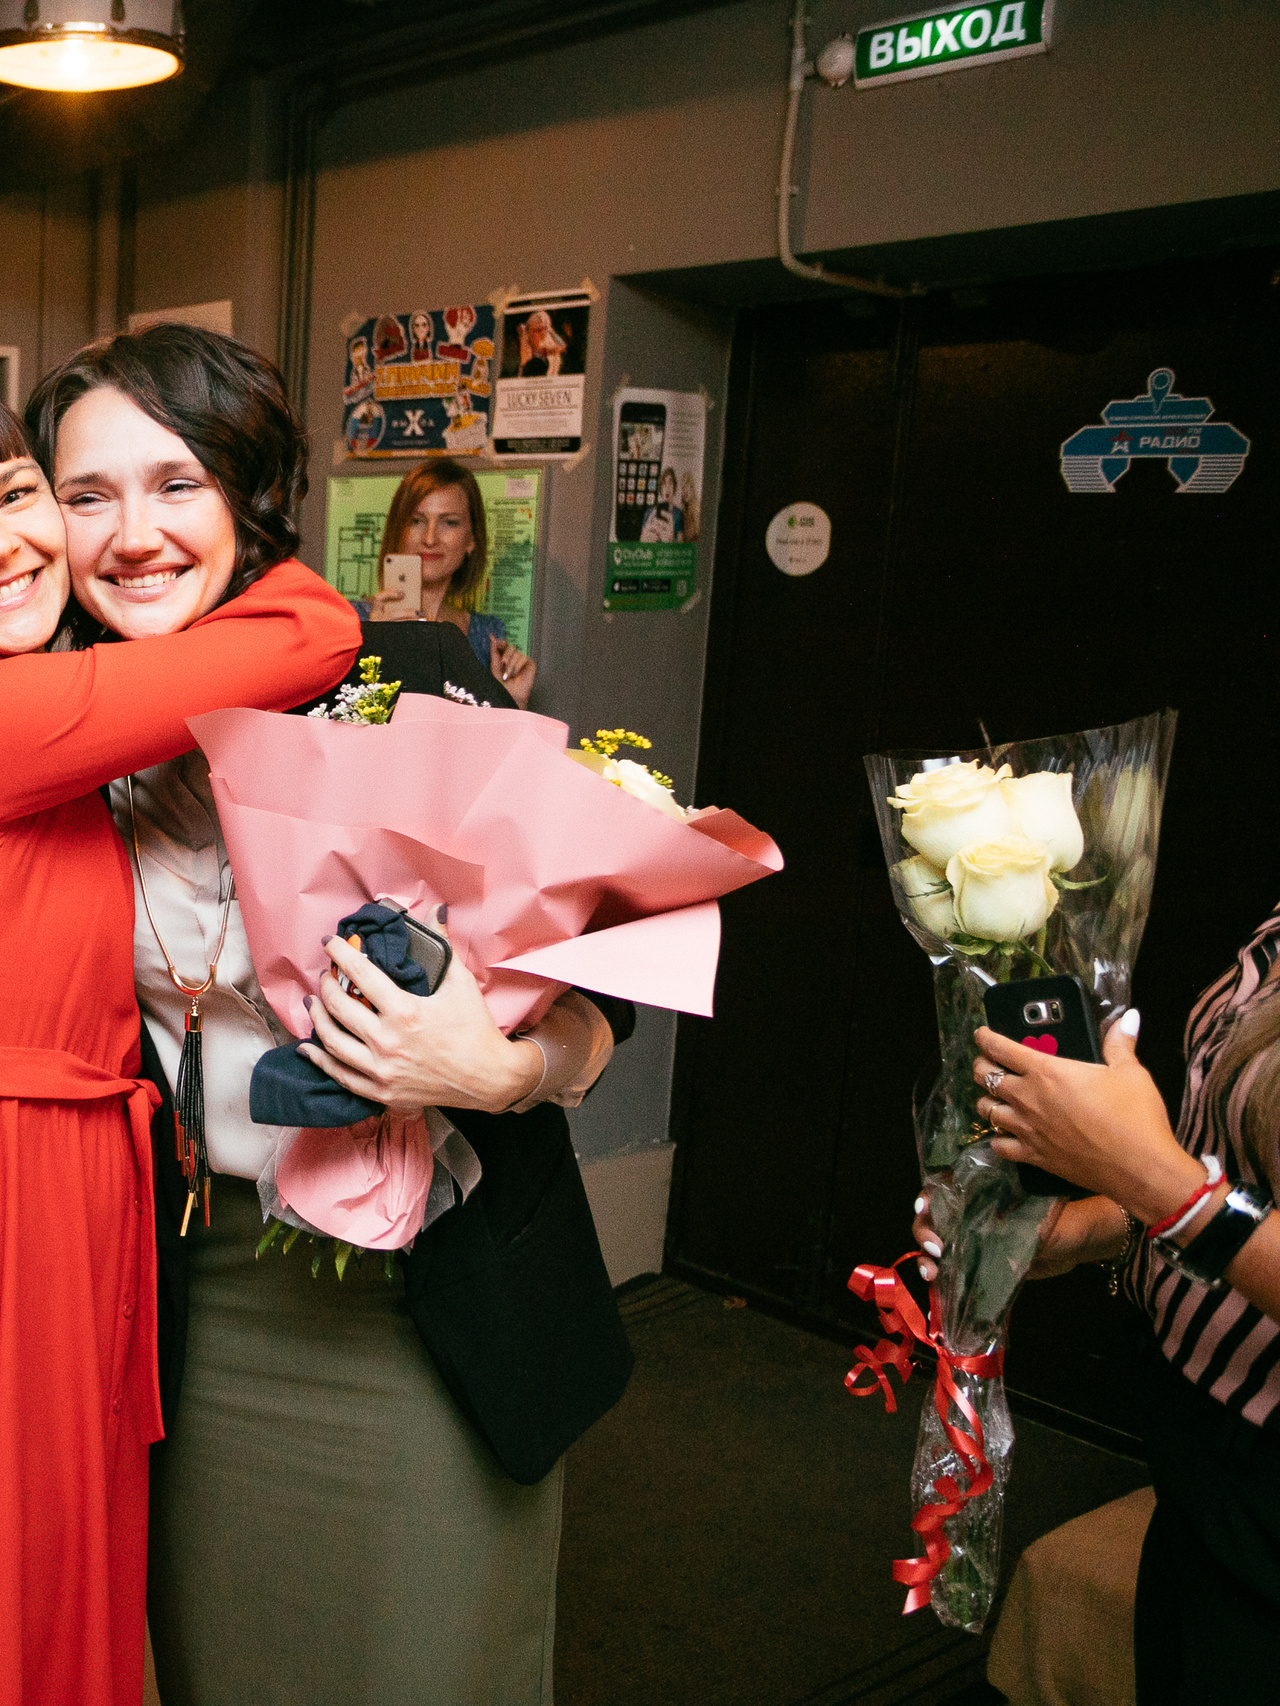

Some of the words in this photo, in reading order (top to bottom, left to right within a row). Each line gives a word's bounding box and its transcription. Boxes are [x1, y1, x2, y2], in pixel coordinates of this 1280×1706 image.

[869, 2, 1026, 69] ВЫХОД
[539, 389, 572, 407] SEVEN
[1139, 436, 1202, 449] РАДИО
